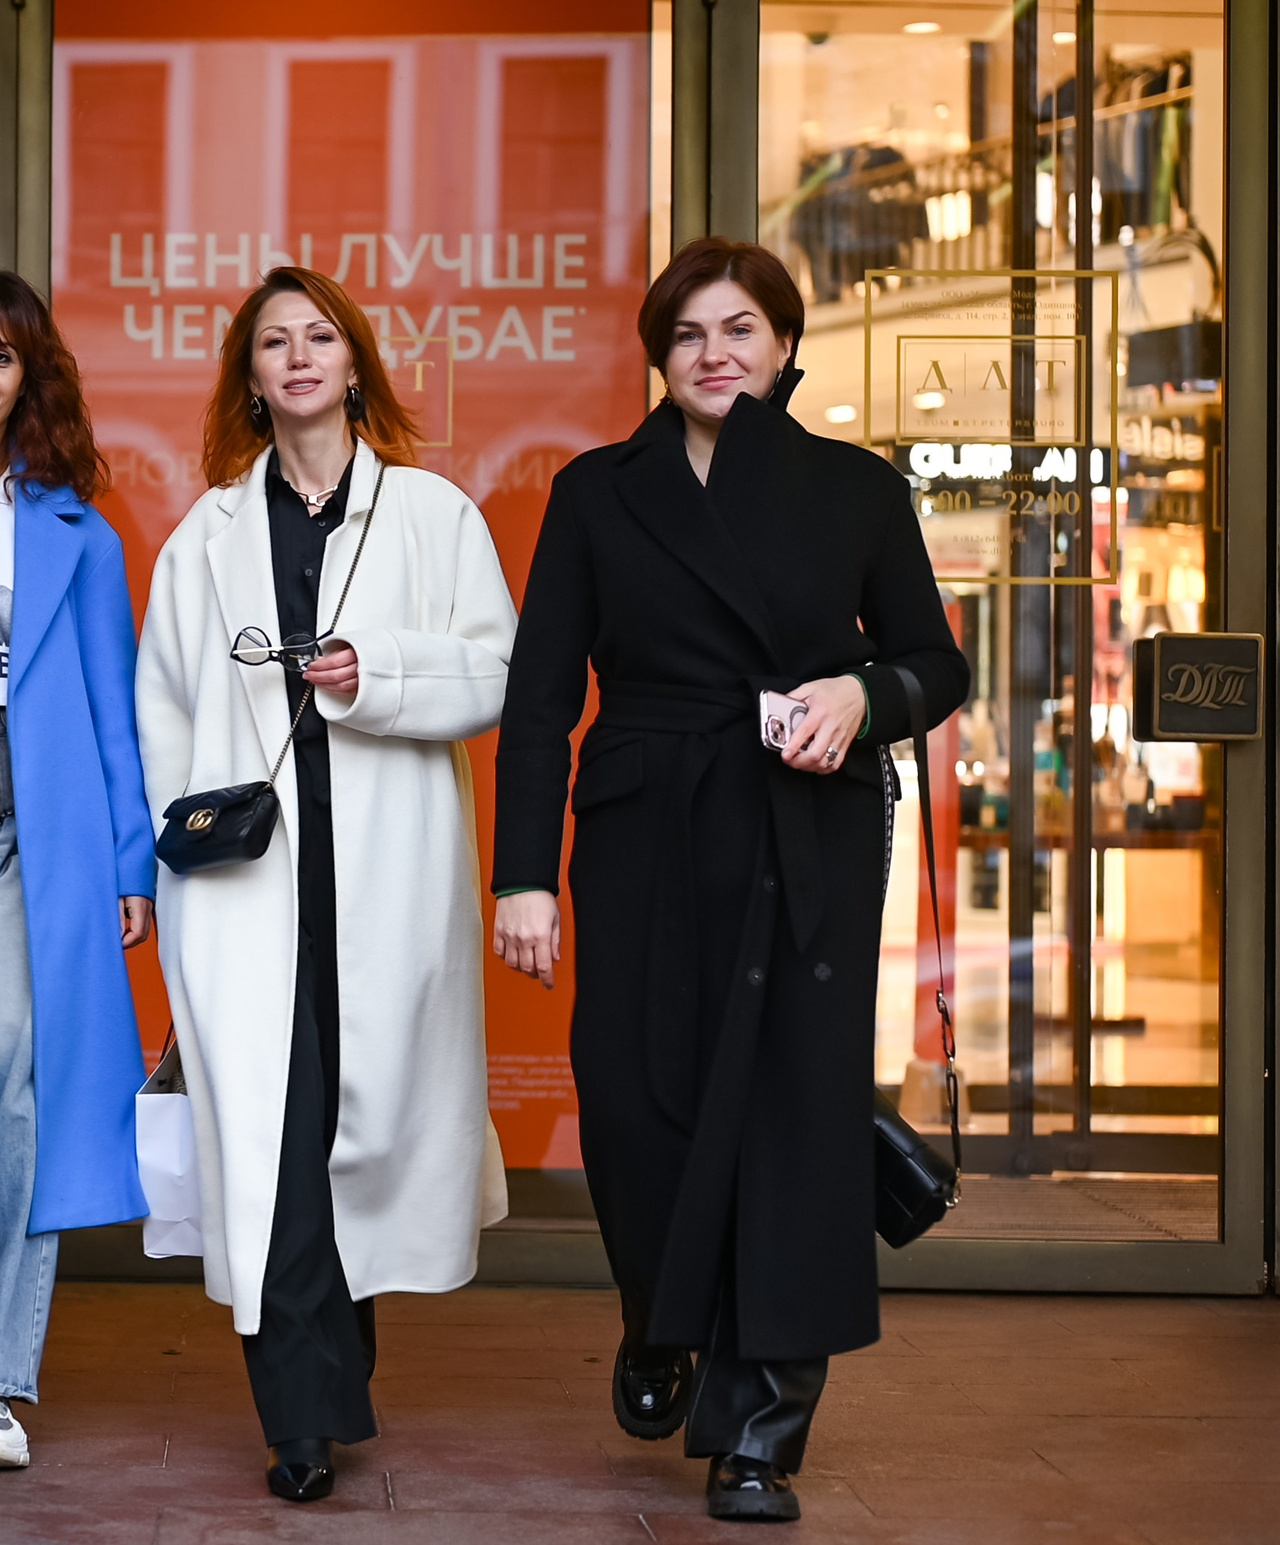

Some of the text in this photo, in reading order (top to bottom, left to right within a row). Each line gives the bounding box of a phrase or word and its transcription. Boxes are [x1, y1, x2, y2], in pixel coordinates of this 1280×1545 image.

[110, 233, 588, 297] ЦЕНЫ ЛУЧШЕ
[1002, 490, 1081, 515] 22:00
